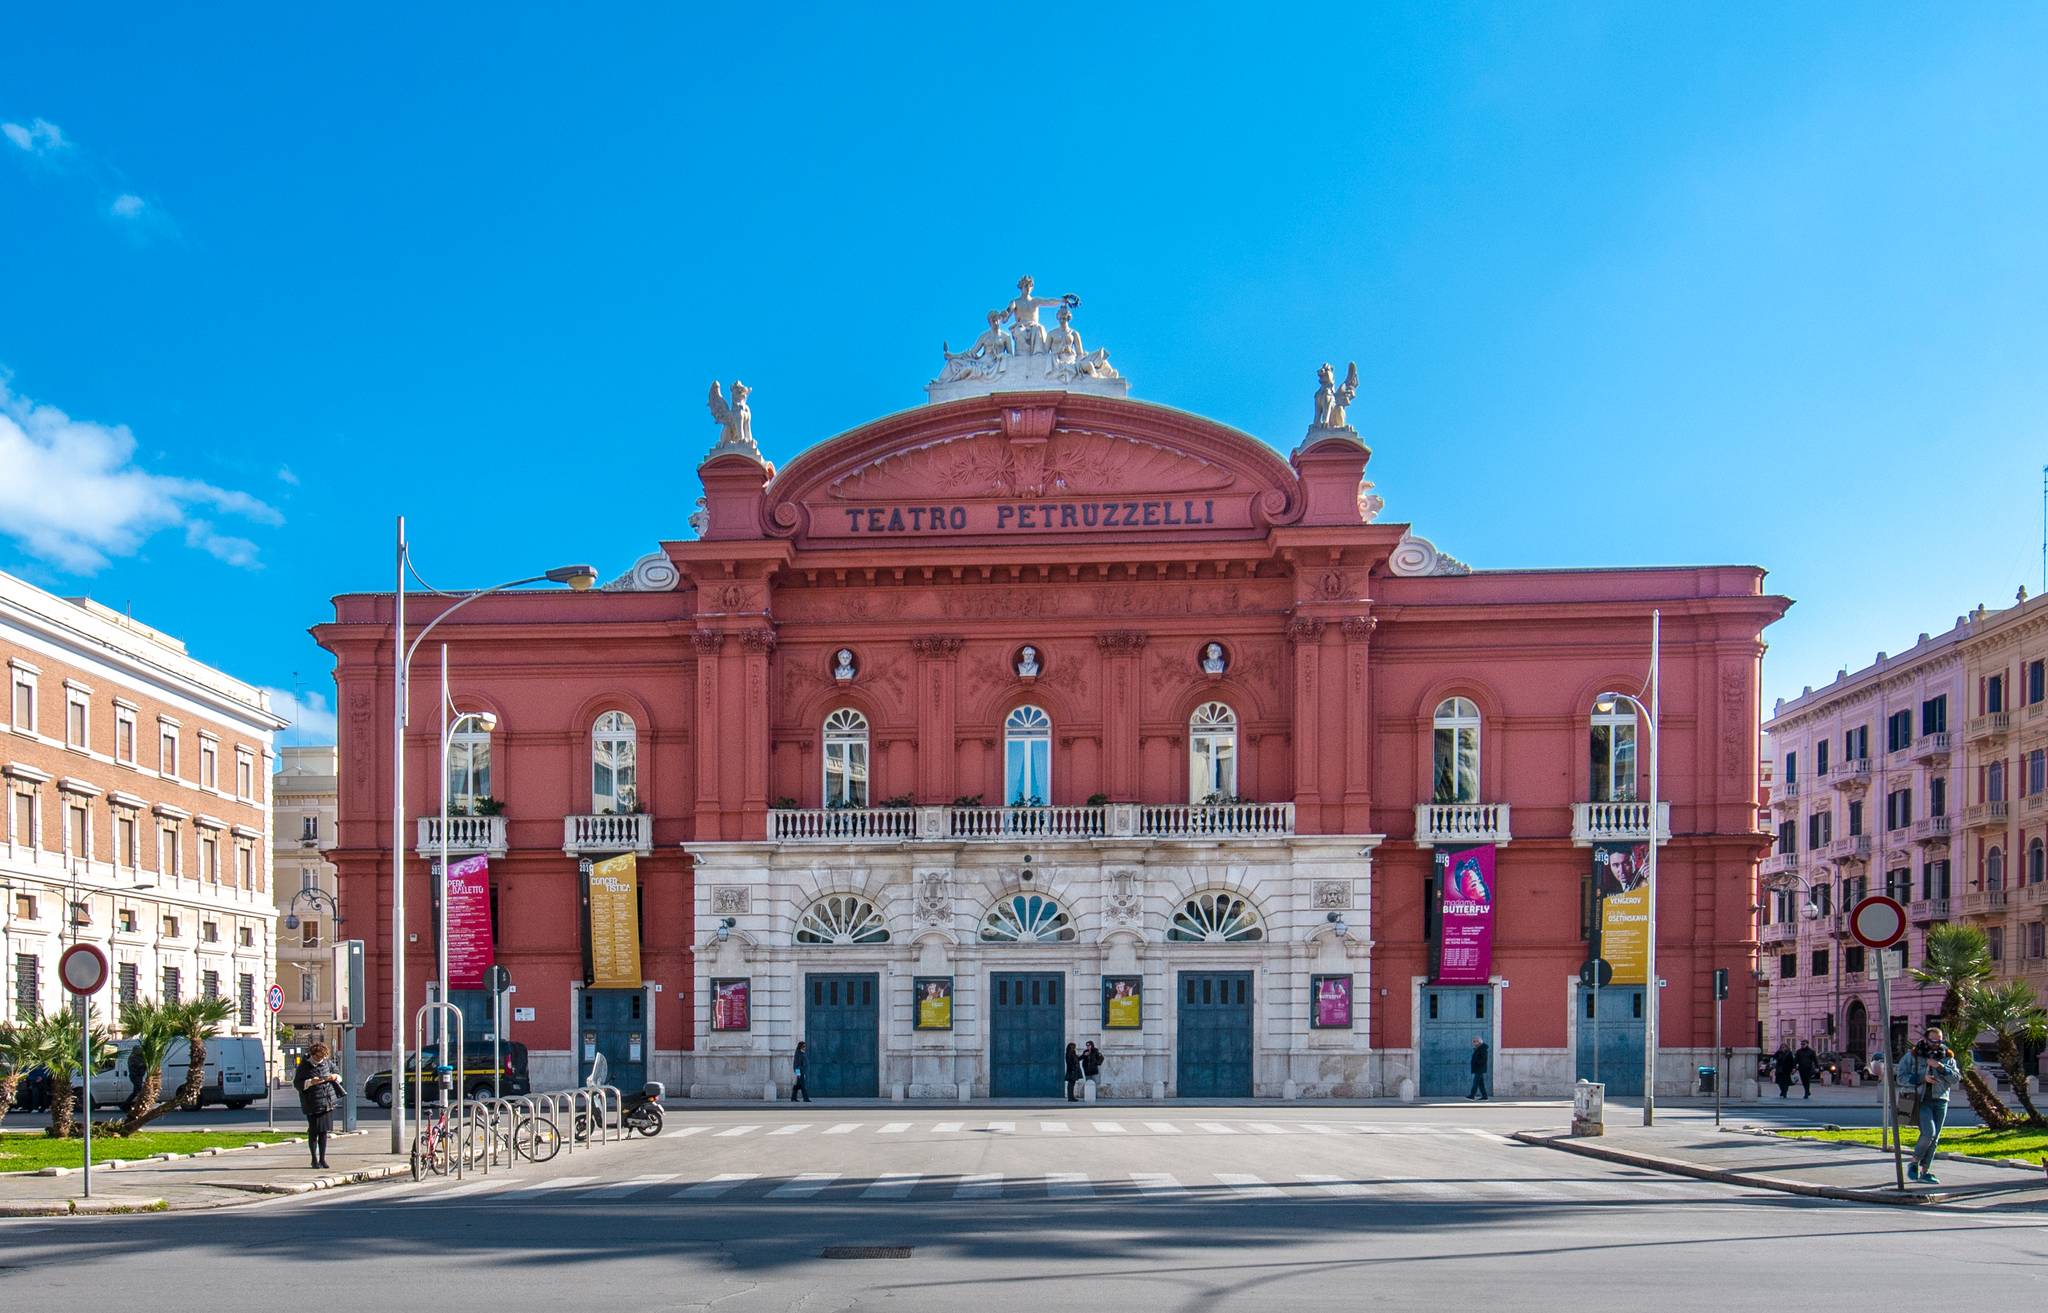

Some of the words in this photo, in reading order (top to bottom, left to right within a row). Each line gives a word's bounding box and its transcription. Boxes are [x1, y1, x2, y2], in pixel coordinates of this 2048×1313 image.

[846, 507, 967, 532] TEATRO
[997, 501, 1214, 529] PETRUZZELLI
[1442, 905, 1490, 914] BUTTERFLY
